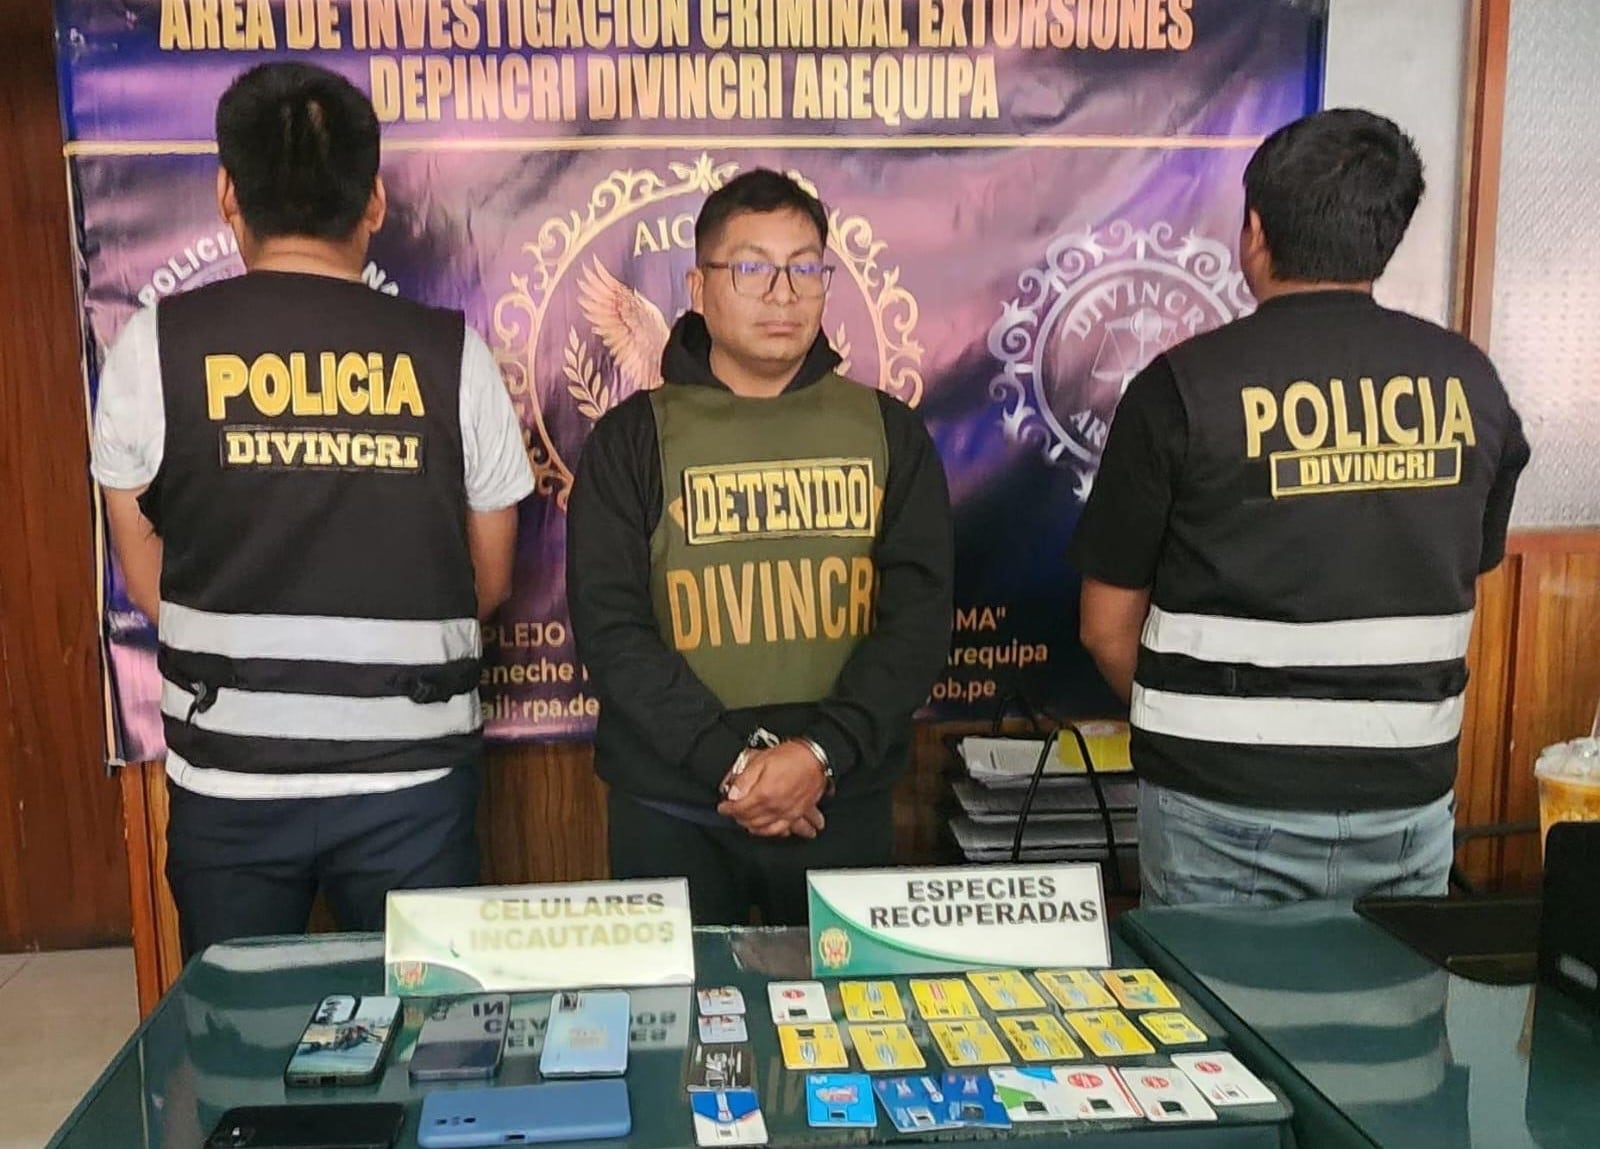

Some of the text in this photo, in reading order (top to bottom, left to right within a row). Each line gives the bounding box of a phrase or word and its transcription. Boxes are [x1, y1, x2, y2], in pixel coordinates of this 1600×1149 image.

[286, 0, 342, 50] DE
[701, 0, 909, 49] CRIMINAL
[918, 0, 1193, 50] EXTORSIONES
[369, 52, 1000, 126] DEPINCRI DIVINCRI AREQUIPA
[633, 213, 695, 257] AIC
[1070, 280, 1205, 341] DIVINCR
[1241, 376, 1476, 458] POLICIA
[225, 432, 419, 468] DIVINCRI
[1300, 450, 1435, 486] DIVINCRI
[692, 467, 868, 535] DETENIDO
[666, 556, 873, 651] DIVINCR
[482, 606, 1006, 648] PLEJO MA"
[947, 638, 1048, 670] requipa
[522, 692, 600, 723] rpa.de
[927, 677, 996, 704] ob.pe
[479, 893, 664, 922] CELULARES
[907, 876, 1056, 902] ESPECIES
[870, 900, 1099, 929] RECUPERADAS
[467, 921, 675, 952] INCAUTADOS
